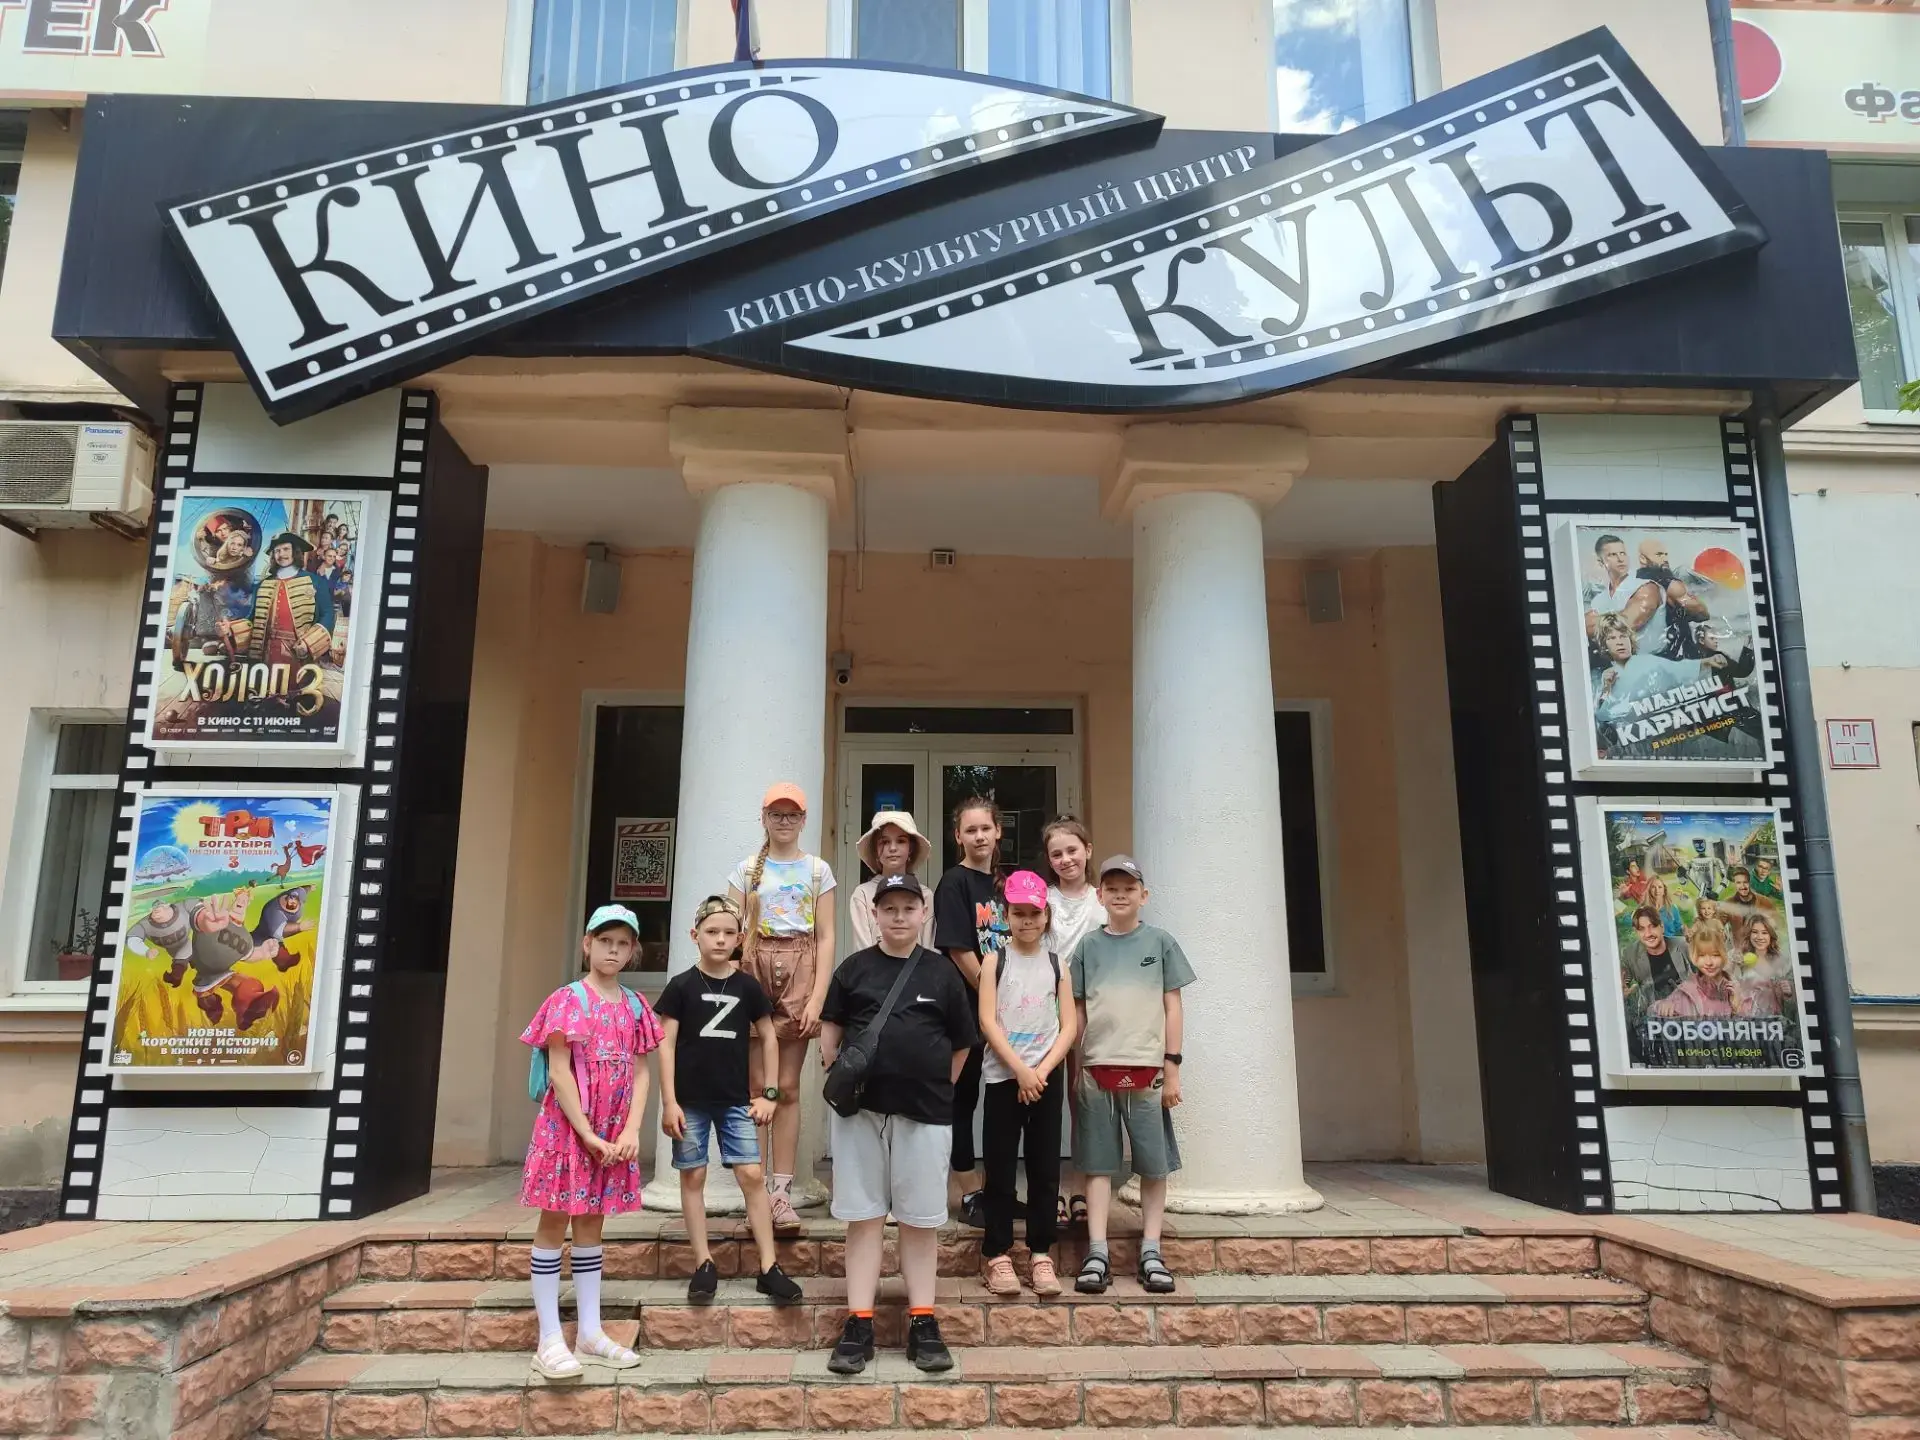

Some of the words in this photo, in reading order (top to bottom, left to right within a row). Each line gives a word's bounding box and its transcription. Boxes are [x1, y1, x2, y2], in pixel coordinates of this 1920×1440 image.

[0, 0, 168, 57] ЕК
[1844, 82, 1920, 120] Фа
[228, 89, 838, 350] КИНО
[1094, 86, 1666, 365] КУЛЬТ
[724, 181, 1126, 334] КИНО-КУЛЬТУРНЫЙ
[1132, 145, 1256, 206] ЦЕНТР
[85, 426, 124, 435] Panasonic
[179, 662, 291, 702] ХОЛОП
[295, 663, 325, 716] 3
[1630, 675, 1724, 716] МАЛЫШ
[197, 717, 205, 726] В
[208, 717, 241, 726] КИНО
[243, 717, 251, 726] С
[253, 717, 262, 726] 11
[265, 717, 301, 726] ИЮНЯ
[1616, 687, 1750, 746] КАРАТИСТ
[1660, 732, 1686, 747] КИНО
[1706, 717, 1736, 732] ИЮНЯ
[199, 810, 275, 838] ТРИ
[228, 856, 240, 868] 3
[187, 1028, 236, 1037] НОВЫЕ
[699, 993, 741, 1039] Z
[1647, 1021, 1784, 1041] РОБОНЯНЯ
[141, 1037, 212, 1047] КОРОТКИЕ
[216, 1037, 279, 1047] ИСТОРИИ
[1677, 1048, 1684, 1057] В
[1685, 1048, 1711, 1057] КИНО
[1711, 1048, 1718, 1057] С
[1719, 1046, 1733, 1058] 18
[1734, 1048, 1763, 1057] ИЮНЯ
